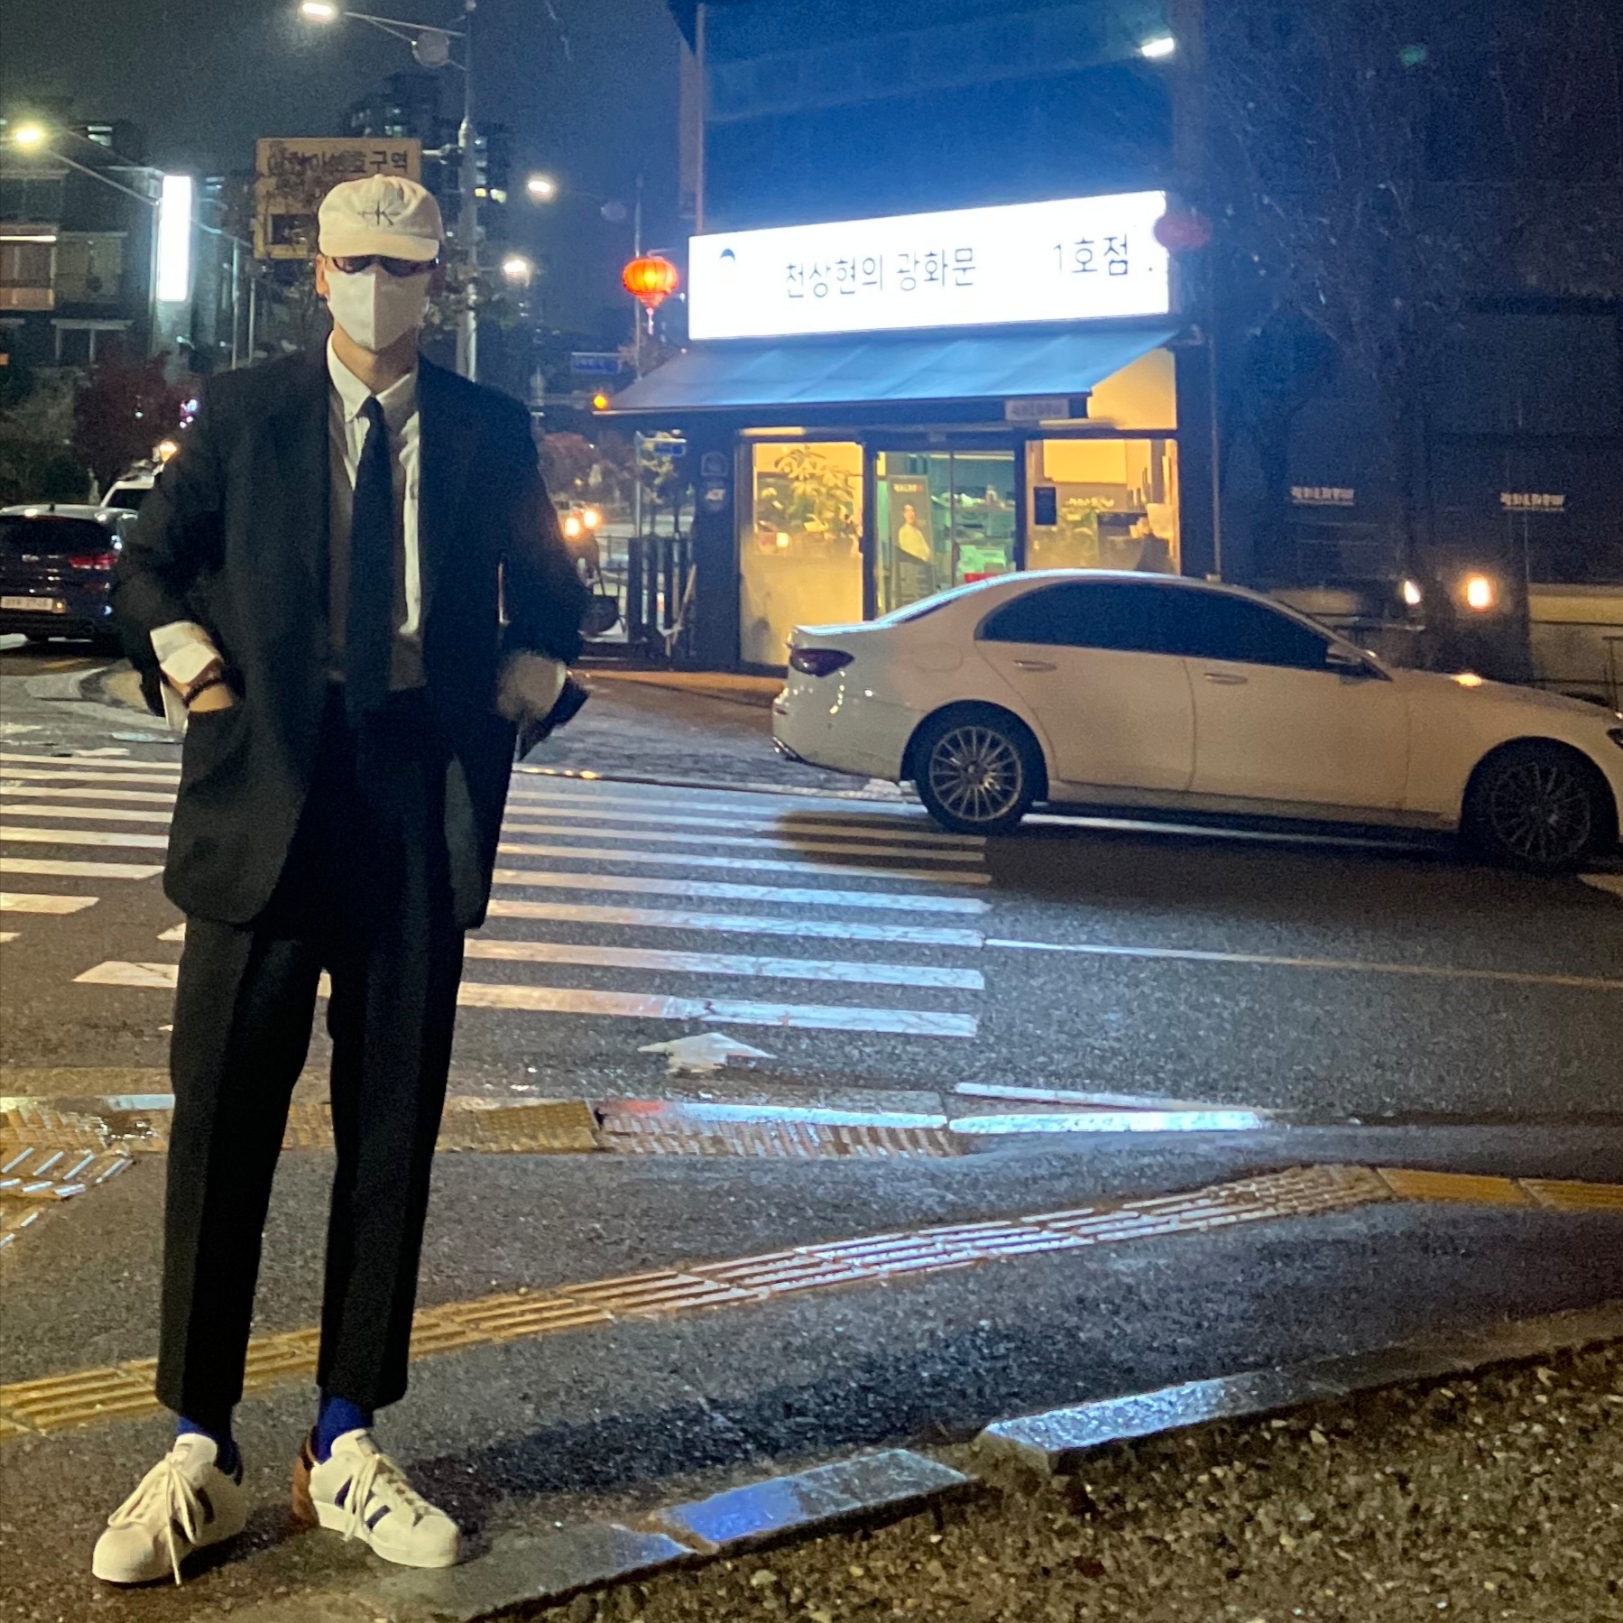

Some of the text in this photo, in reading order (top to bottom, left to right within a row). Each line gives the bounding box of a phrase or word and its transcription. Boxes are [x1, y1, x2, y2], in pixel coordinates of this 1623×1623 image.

[786, 234, 1128, 298] 천상현의 광화문 1호점
